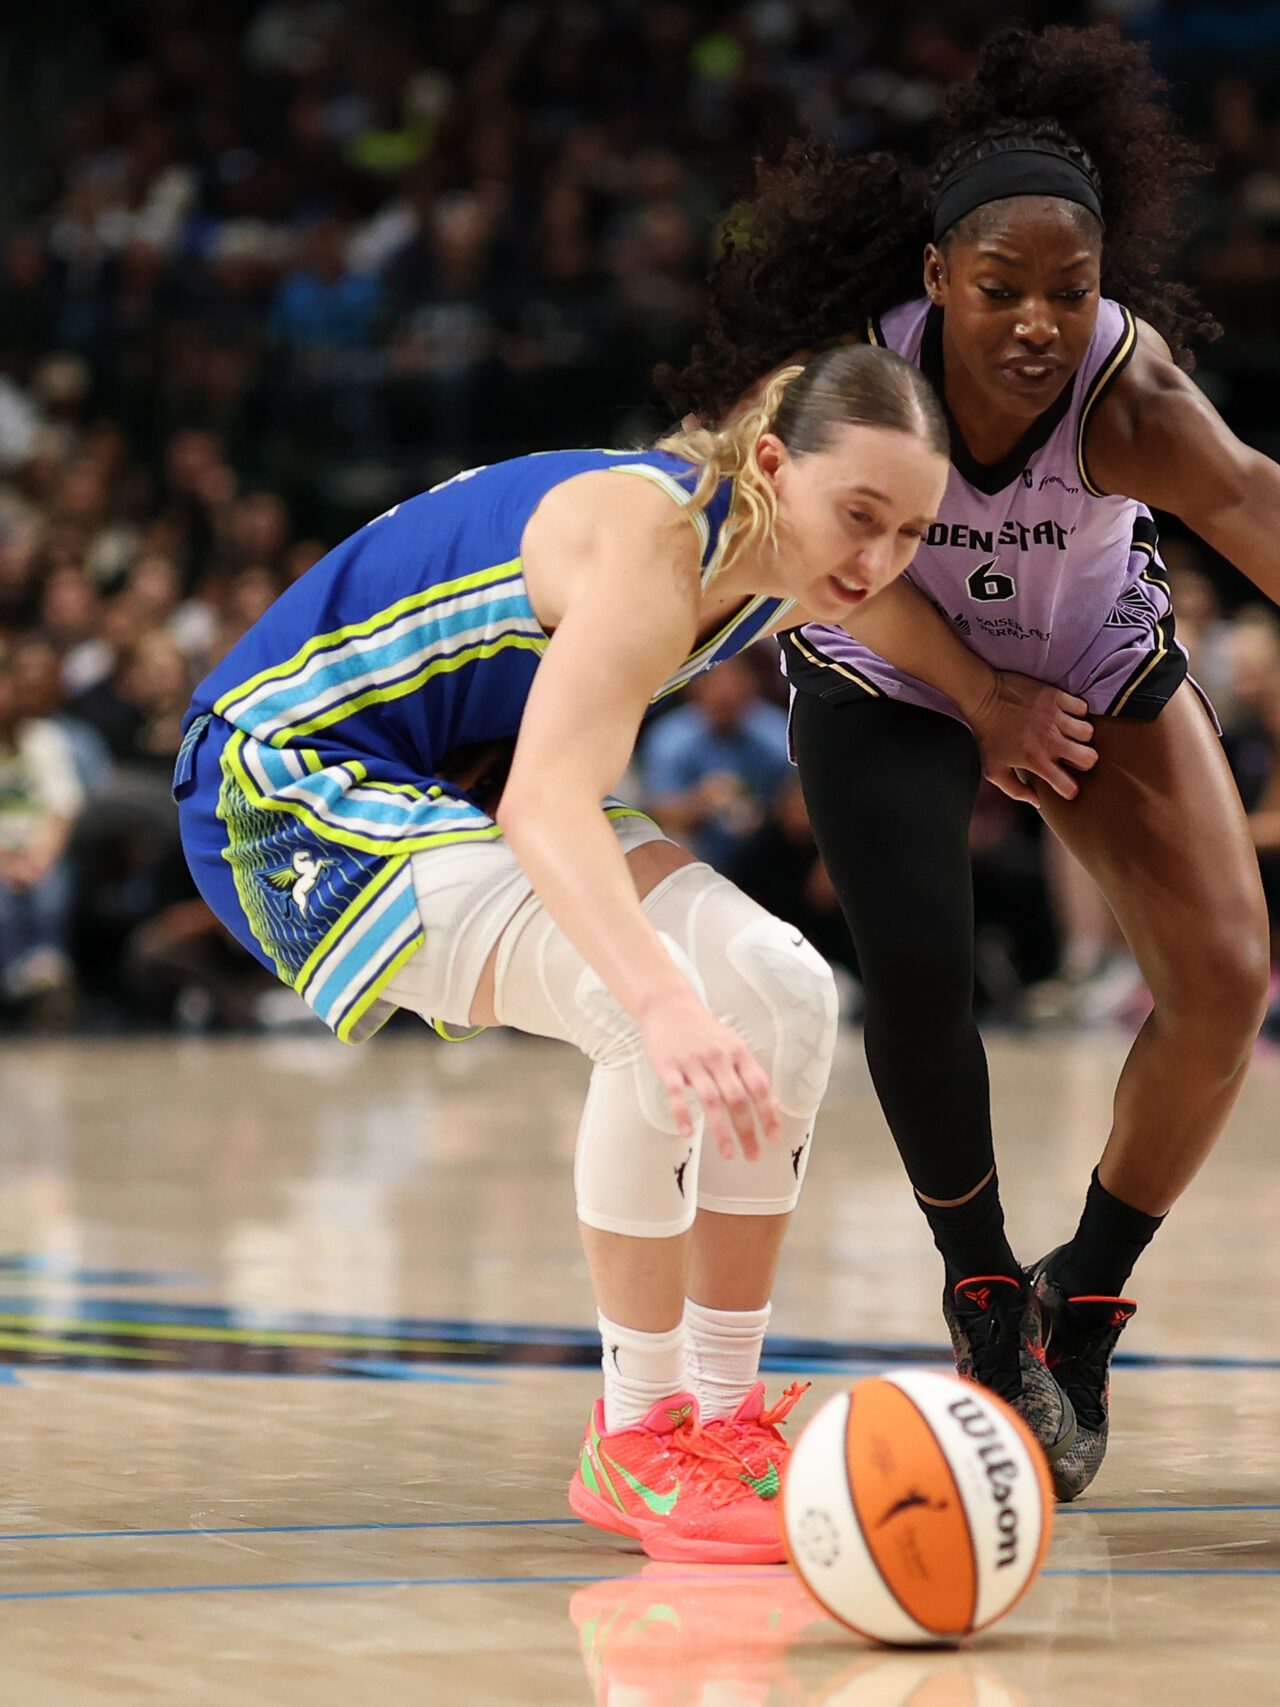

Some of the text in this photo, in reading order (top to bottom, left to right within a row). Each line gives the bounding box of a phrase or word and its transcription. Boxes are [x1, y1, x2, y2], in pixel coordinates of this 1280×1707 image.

[998, 519, 1078, 552] STAT
[966, 554, 1017, 602] 6
[947, 1396, 1020, 1571] Wilson
